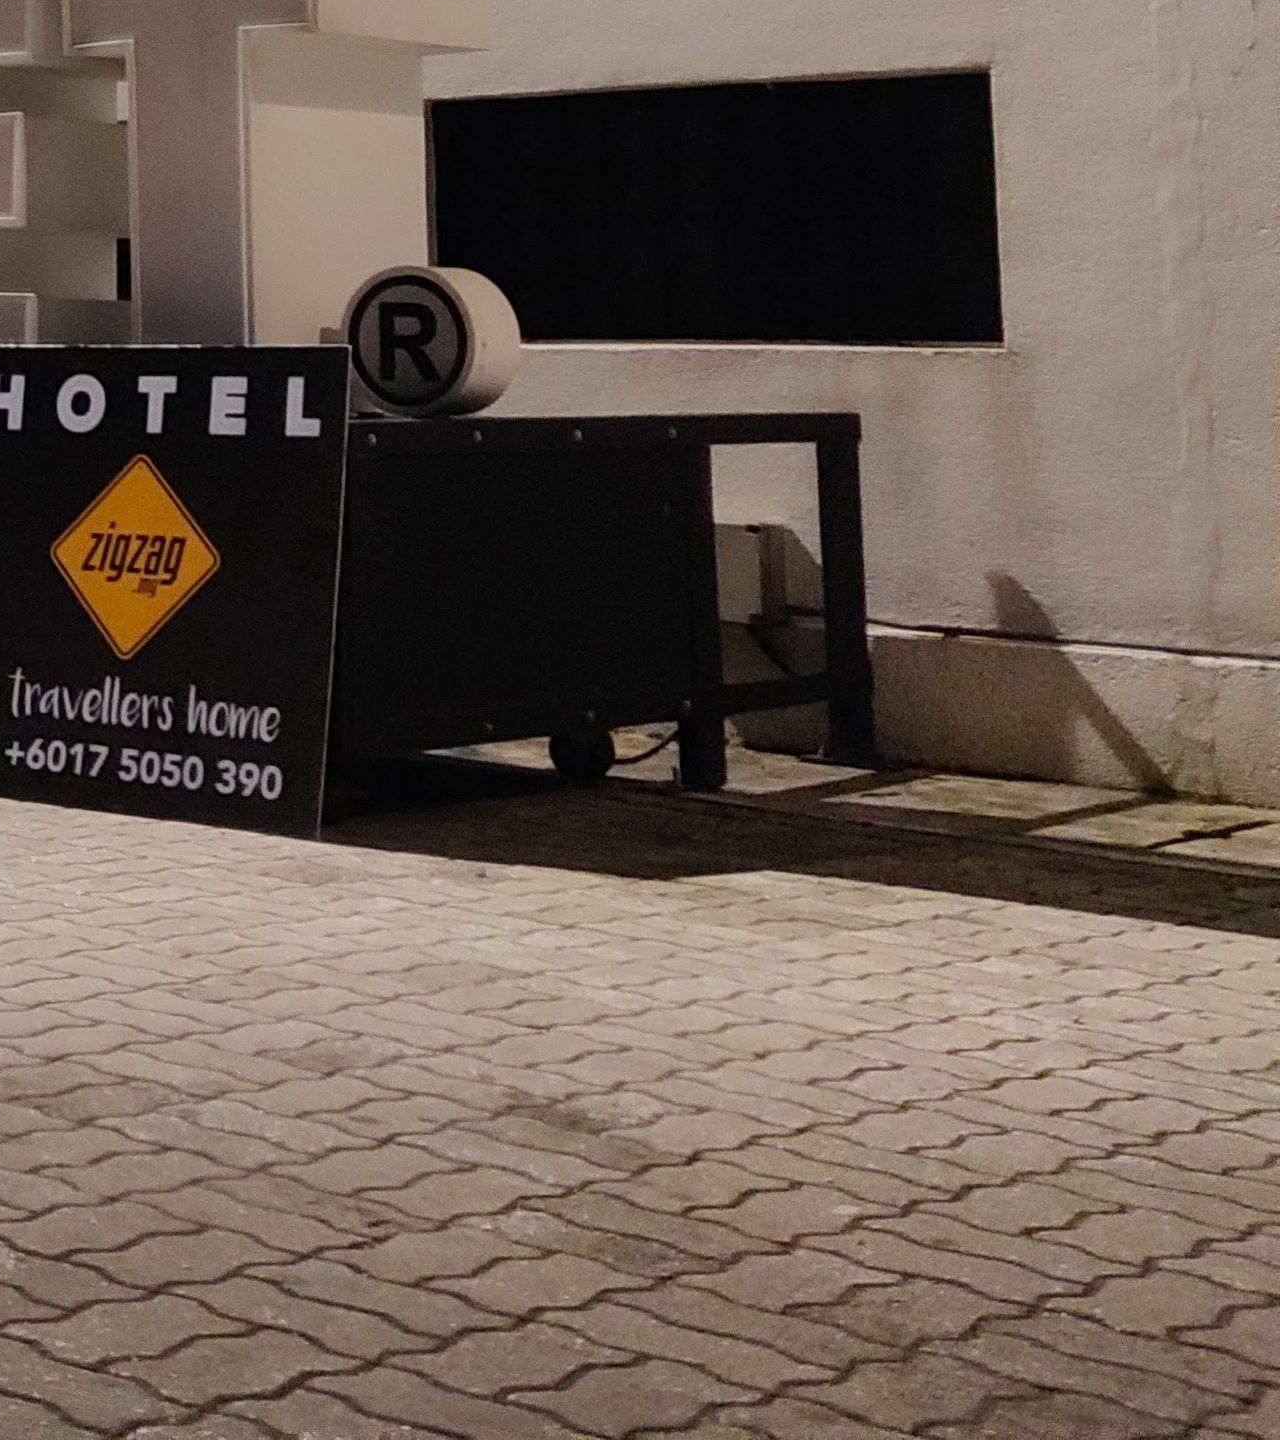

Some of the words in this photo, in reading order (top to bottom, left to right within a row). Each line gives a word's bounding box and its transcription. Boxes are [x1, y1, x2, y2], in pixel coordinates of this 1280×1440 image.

[81, 520, 188, 586] zigzag
[7, 666, 175, 732] travellers
[186, 683, 282, 744] home
[3, 738, 109, 778] +6017
[117, 747, 205, 791] 5050
[214, 759, 284, 800] 390
